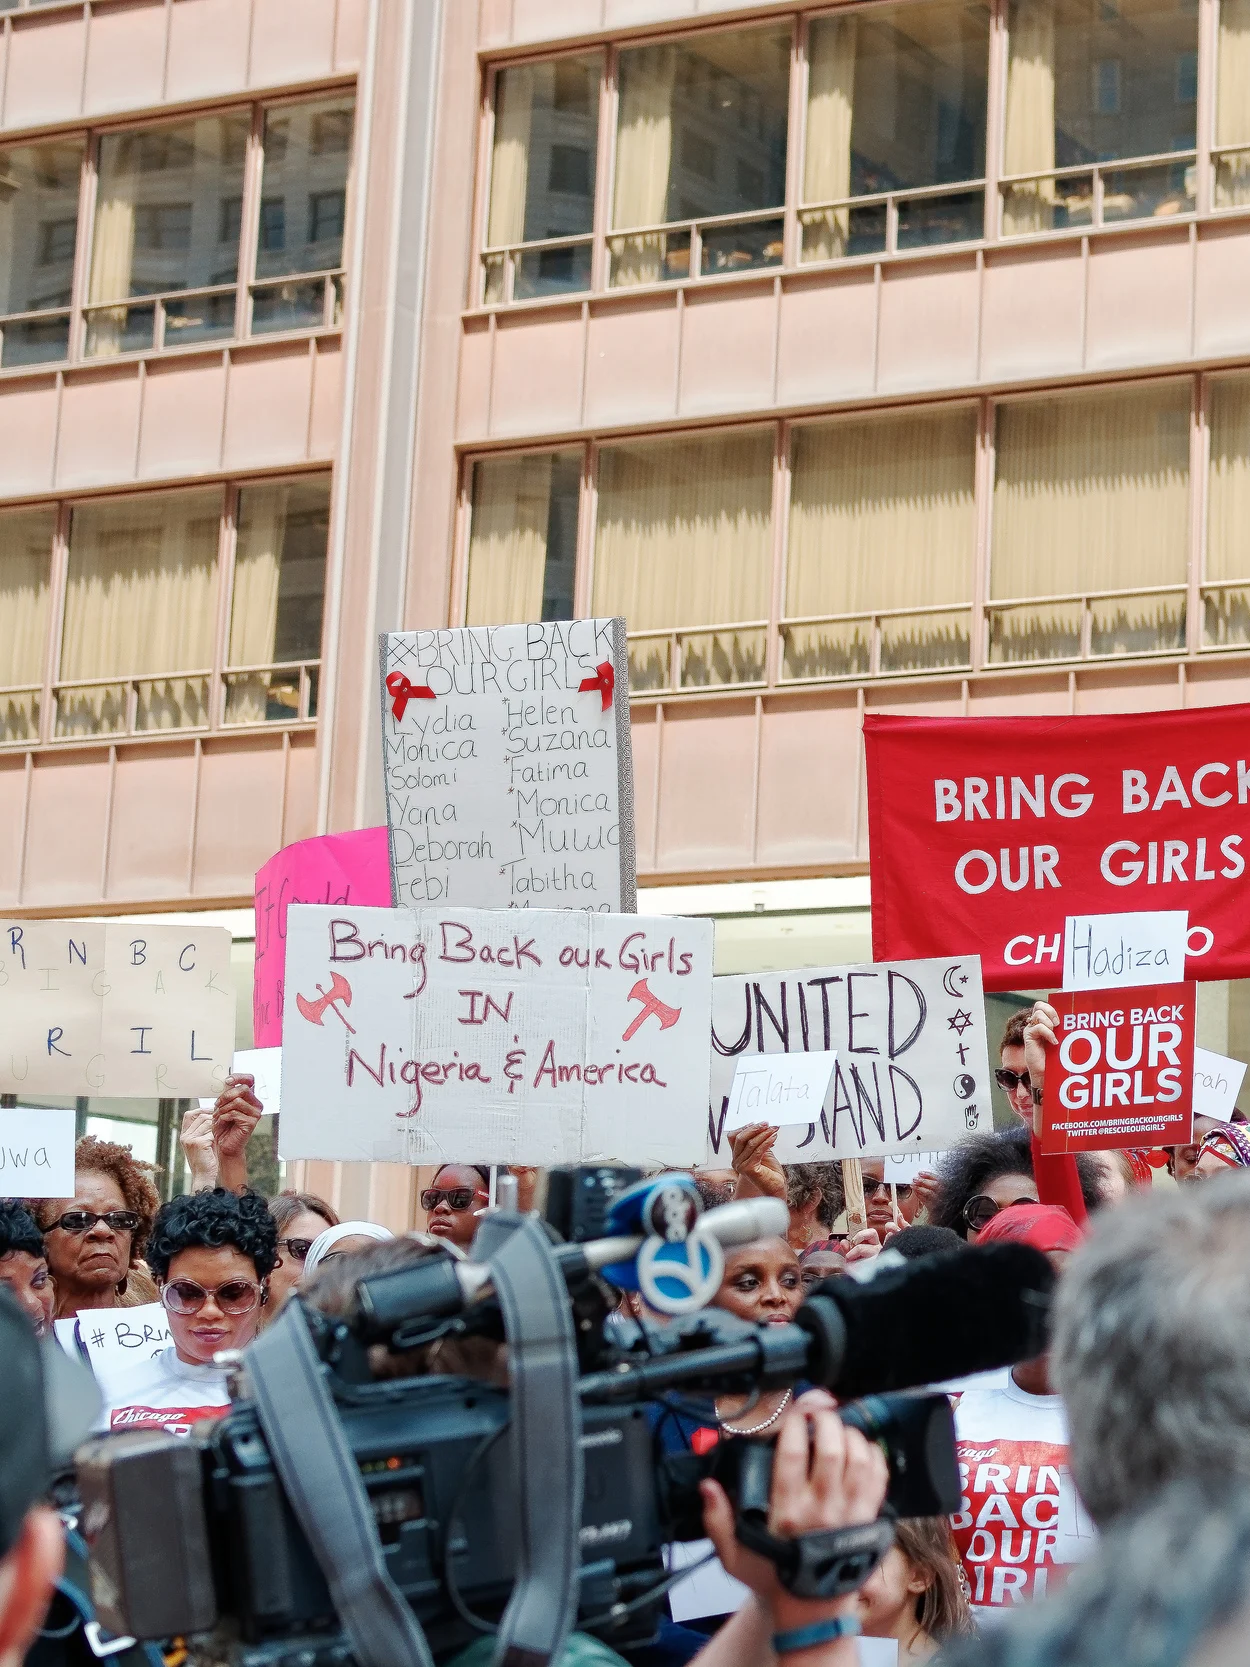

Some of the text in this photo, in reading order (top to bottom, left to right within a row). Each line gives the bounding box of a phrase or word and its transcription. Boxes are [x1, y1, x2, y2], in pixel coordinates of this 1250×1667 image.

[526, 617, 614, 661] BACK
[426, 661, 502, 696] OUR
[392, 704, 477, 752] Lydia
[507, 695, 578, 728] Helen
[386, 735, 478, 765] Monica
[506, 725, 612, 754] Suzana
[510, 754, 589, 784] Fatima
[388, 792, 458, 826] Yana
[517, 788, 612, 818] Monica
[934, 773, 1095, 822] BRING
[392, 826, 494, 865] Deborah
[395, 864, 449, 901] Febi
[500, 857, 597, 895] Tabitha
[954, 834, 1246, 895] OUR GIRLS
[329, 919, 427, 999] Bring
[439, 921, 543, 969] Back
[618, 932, 693, 976] Girls
[1072, 918, 1170, 980] Hadiza
[457, 989, 515, 1025] IN
[711, 969, 928, 1061] UNITED
[1063, 1004, 1185, 1031] BRING BACK
[1058, 1022, 1183, 1074] OUR
[345, 1043, 492, 1119] Nigeria
[533, 1039, 668, 1090] America
[737, 1069, 810, 1115] Talata
[1058, 1067, 1183, 1110] GIRLS
[797, 1058, 922, 1149] AND.
[1051, 1113, 1184, 1131] FACEBOOK.COM/BRINGBACKOURGIRLS
[1066, 1123, 1166, 1137] TWITTER @RESCUEOURGIRLS
[113, 1408, 187, 1425] Chicago
[959, 1463, 1061, 1494] RIN
[950, 1493, 1060, 1530] BAC
[965, 1529, 1059, 1565] OUR
